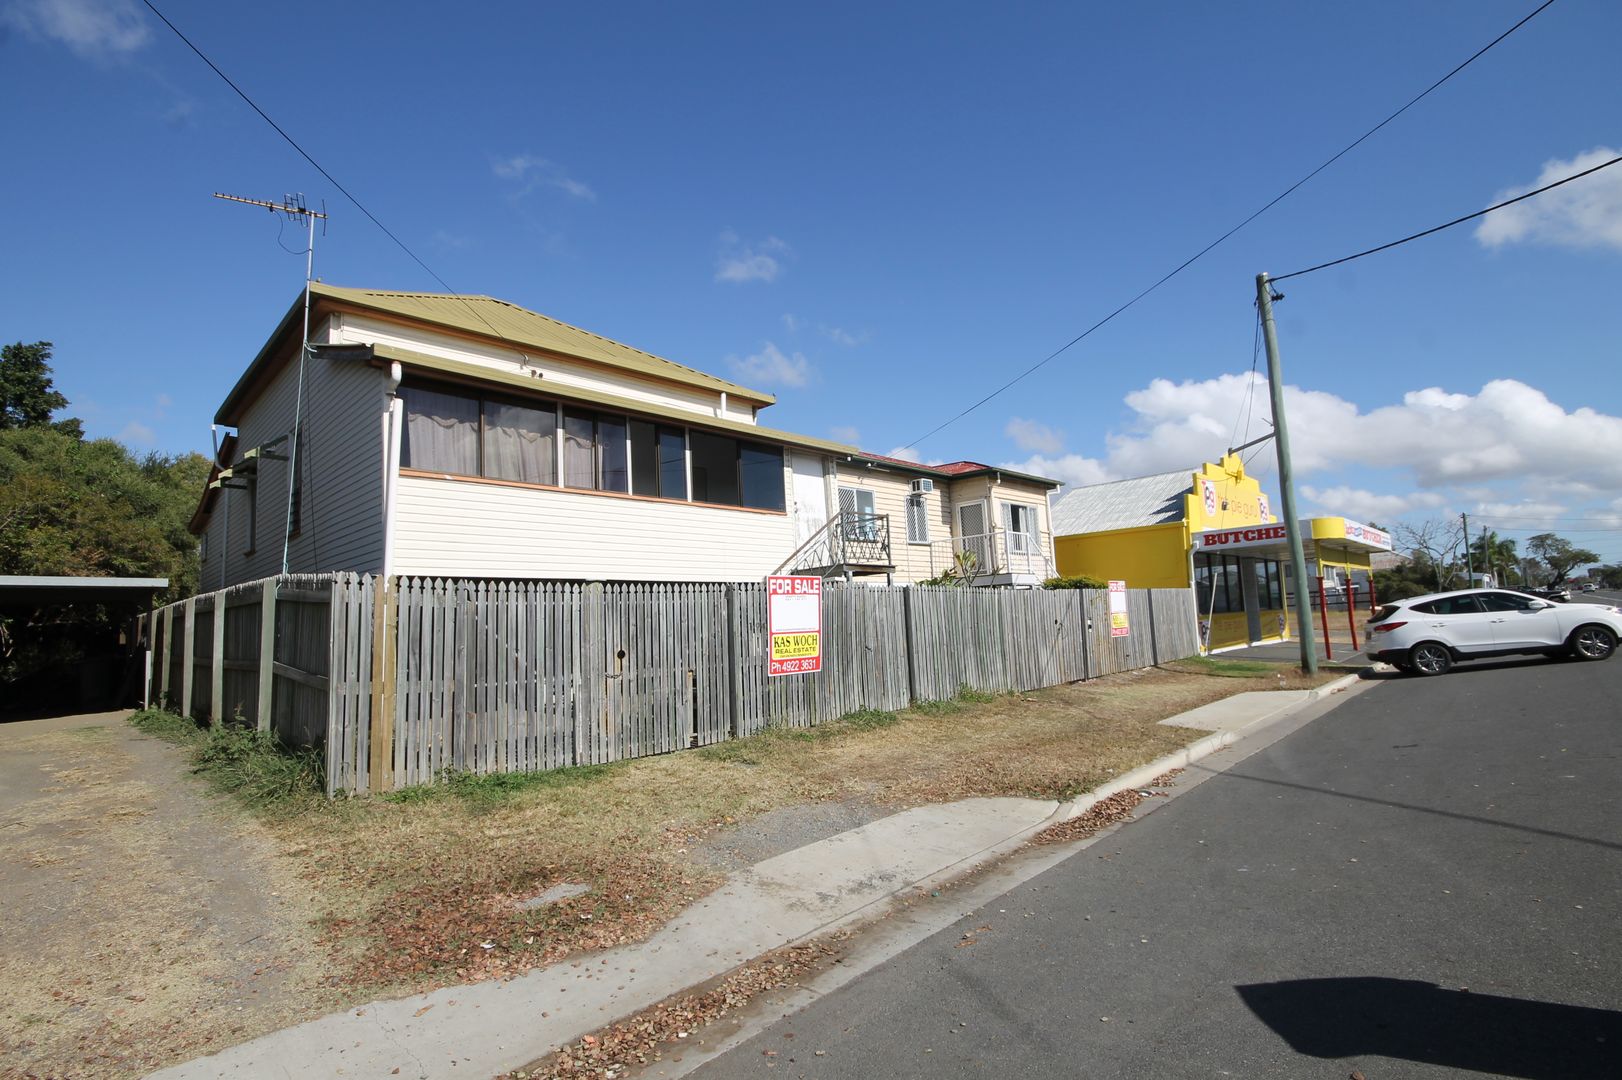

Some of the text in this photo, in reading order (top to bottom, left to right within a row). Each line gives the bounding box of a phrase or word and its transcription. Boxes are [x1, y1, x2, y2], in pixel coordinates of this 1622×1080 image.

[1203, 526, 1287, 546] BUTCHE
[770, 579, 820, 594] FOR SALE
[773, 634, 818, 648] KAS WOCH
[771, 659, 816, 673] Ph 4922 3631
